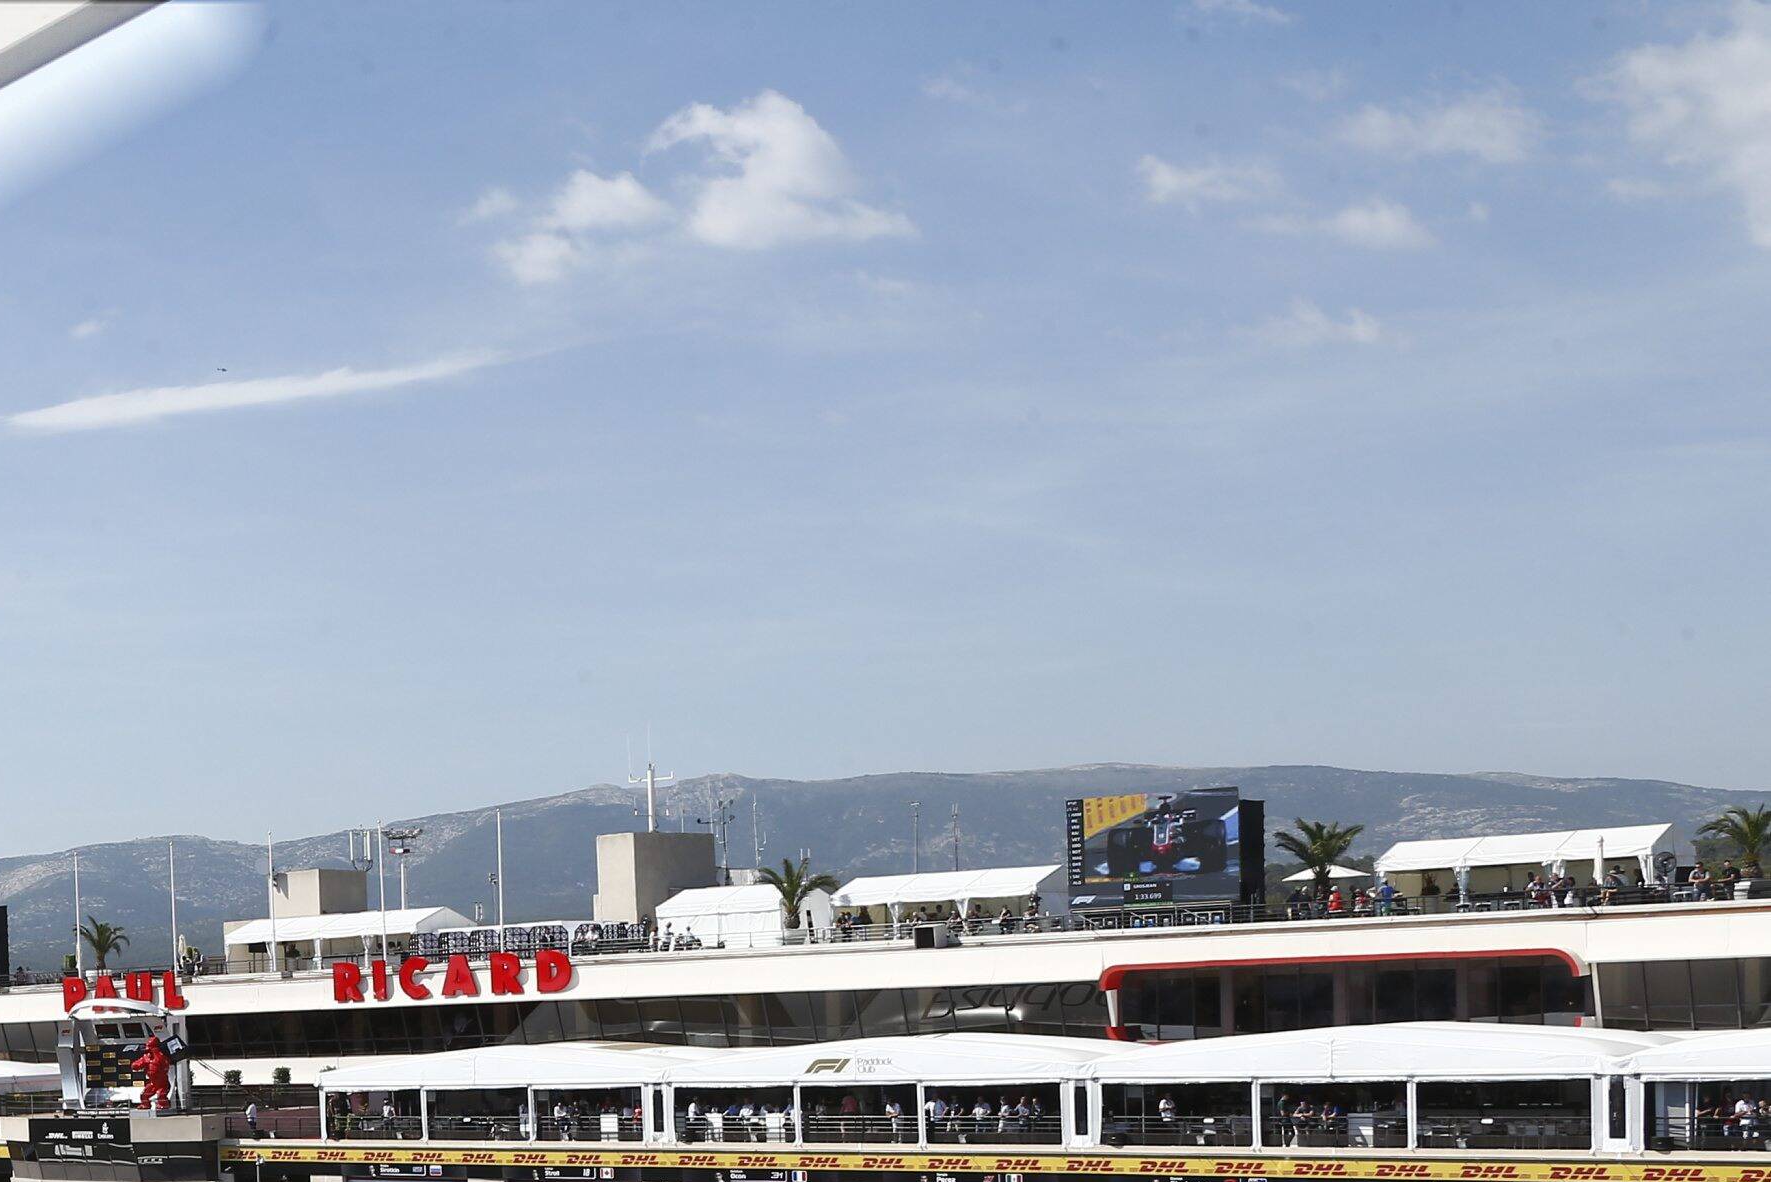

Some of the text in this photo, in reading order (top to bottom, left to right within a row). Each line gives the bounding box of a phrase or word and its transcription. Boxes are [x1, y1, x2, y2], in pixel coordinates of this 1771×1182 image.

[62, 949, 572, 1012] PAUL RICARD
[804, 1057, 893, 1074] F1 Paddock
[271, 1151, 301, 1160] DHL
[316, 1152, 348, 1160] DHL
[363, 1152, 396, 1162] DHL
[411, 1153, 445, 1162] DHL
[462, 1154, 496, 1163] DHL
[512, 1154, 548, 1164] DHL
[566, 1154, 603, 1164] DHL
[621, 1155, 659, 1165] DHL
[678, 1156, 718, 1166] DHL
[738, 1156, 778, 1166] DHL
[798, 1157, 841, 1168] DHL
[862, 1158, 906, 1168] DHL
[928, 1158, 973, 1170] DHL
[995, 1159, 1042, 1170] DHL
[1066, 1160, 1114, 1172] DHL
[1139, 1161, 1189, 1173] DHL
[1214, 1162, 1267, 1174] DHL
[1294, 1164, 1347, 1176] DHL
[1375, 1164, 1431, 1177] DHL
[1461, 1166, 1519, 1178] DHL
[1549, 1167, 1611, 1180] DHL
[1642, 1168, 1706, 1181] DHL
